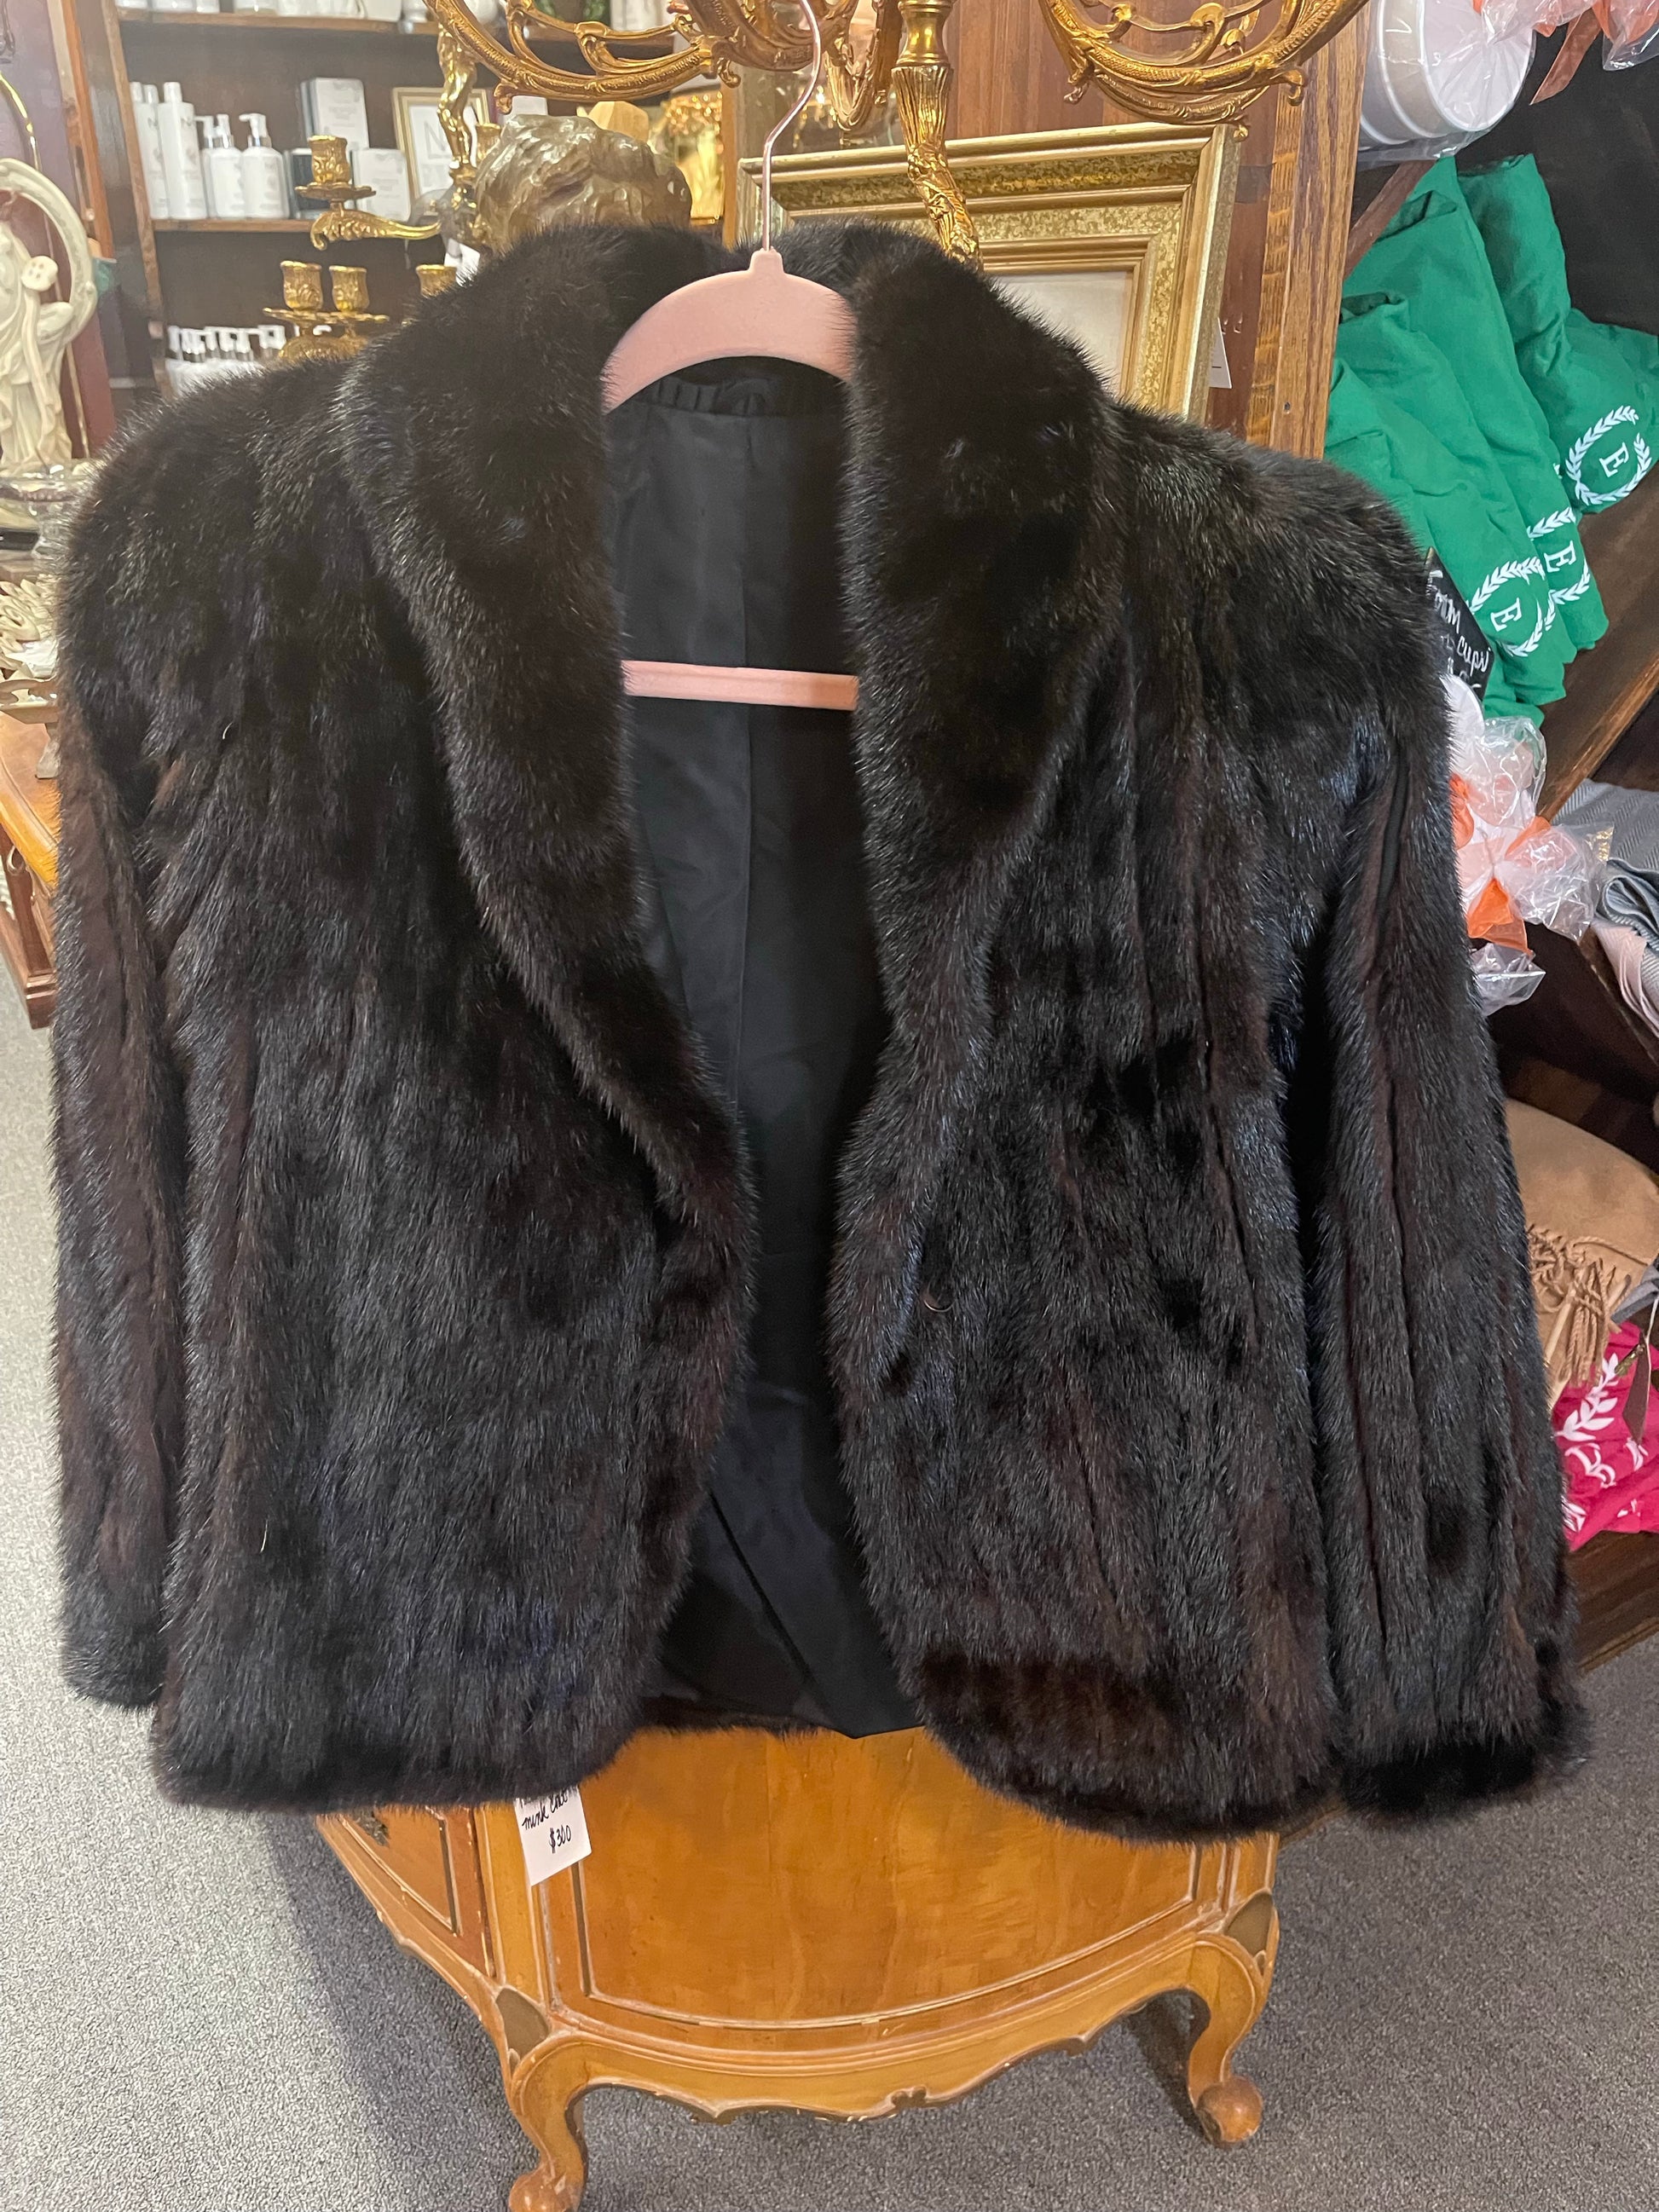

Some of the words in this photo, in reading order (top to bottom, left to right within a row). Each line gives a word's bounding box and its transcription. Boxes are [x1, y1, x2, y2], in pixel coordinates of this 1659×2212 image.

[1598, 442, 1629, 477] E
[1544, 540, 1576, 573] E
[1490, 597, 1522, 632] E
[549, 1824, 572, 1854] $300
